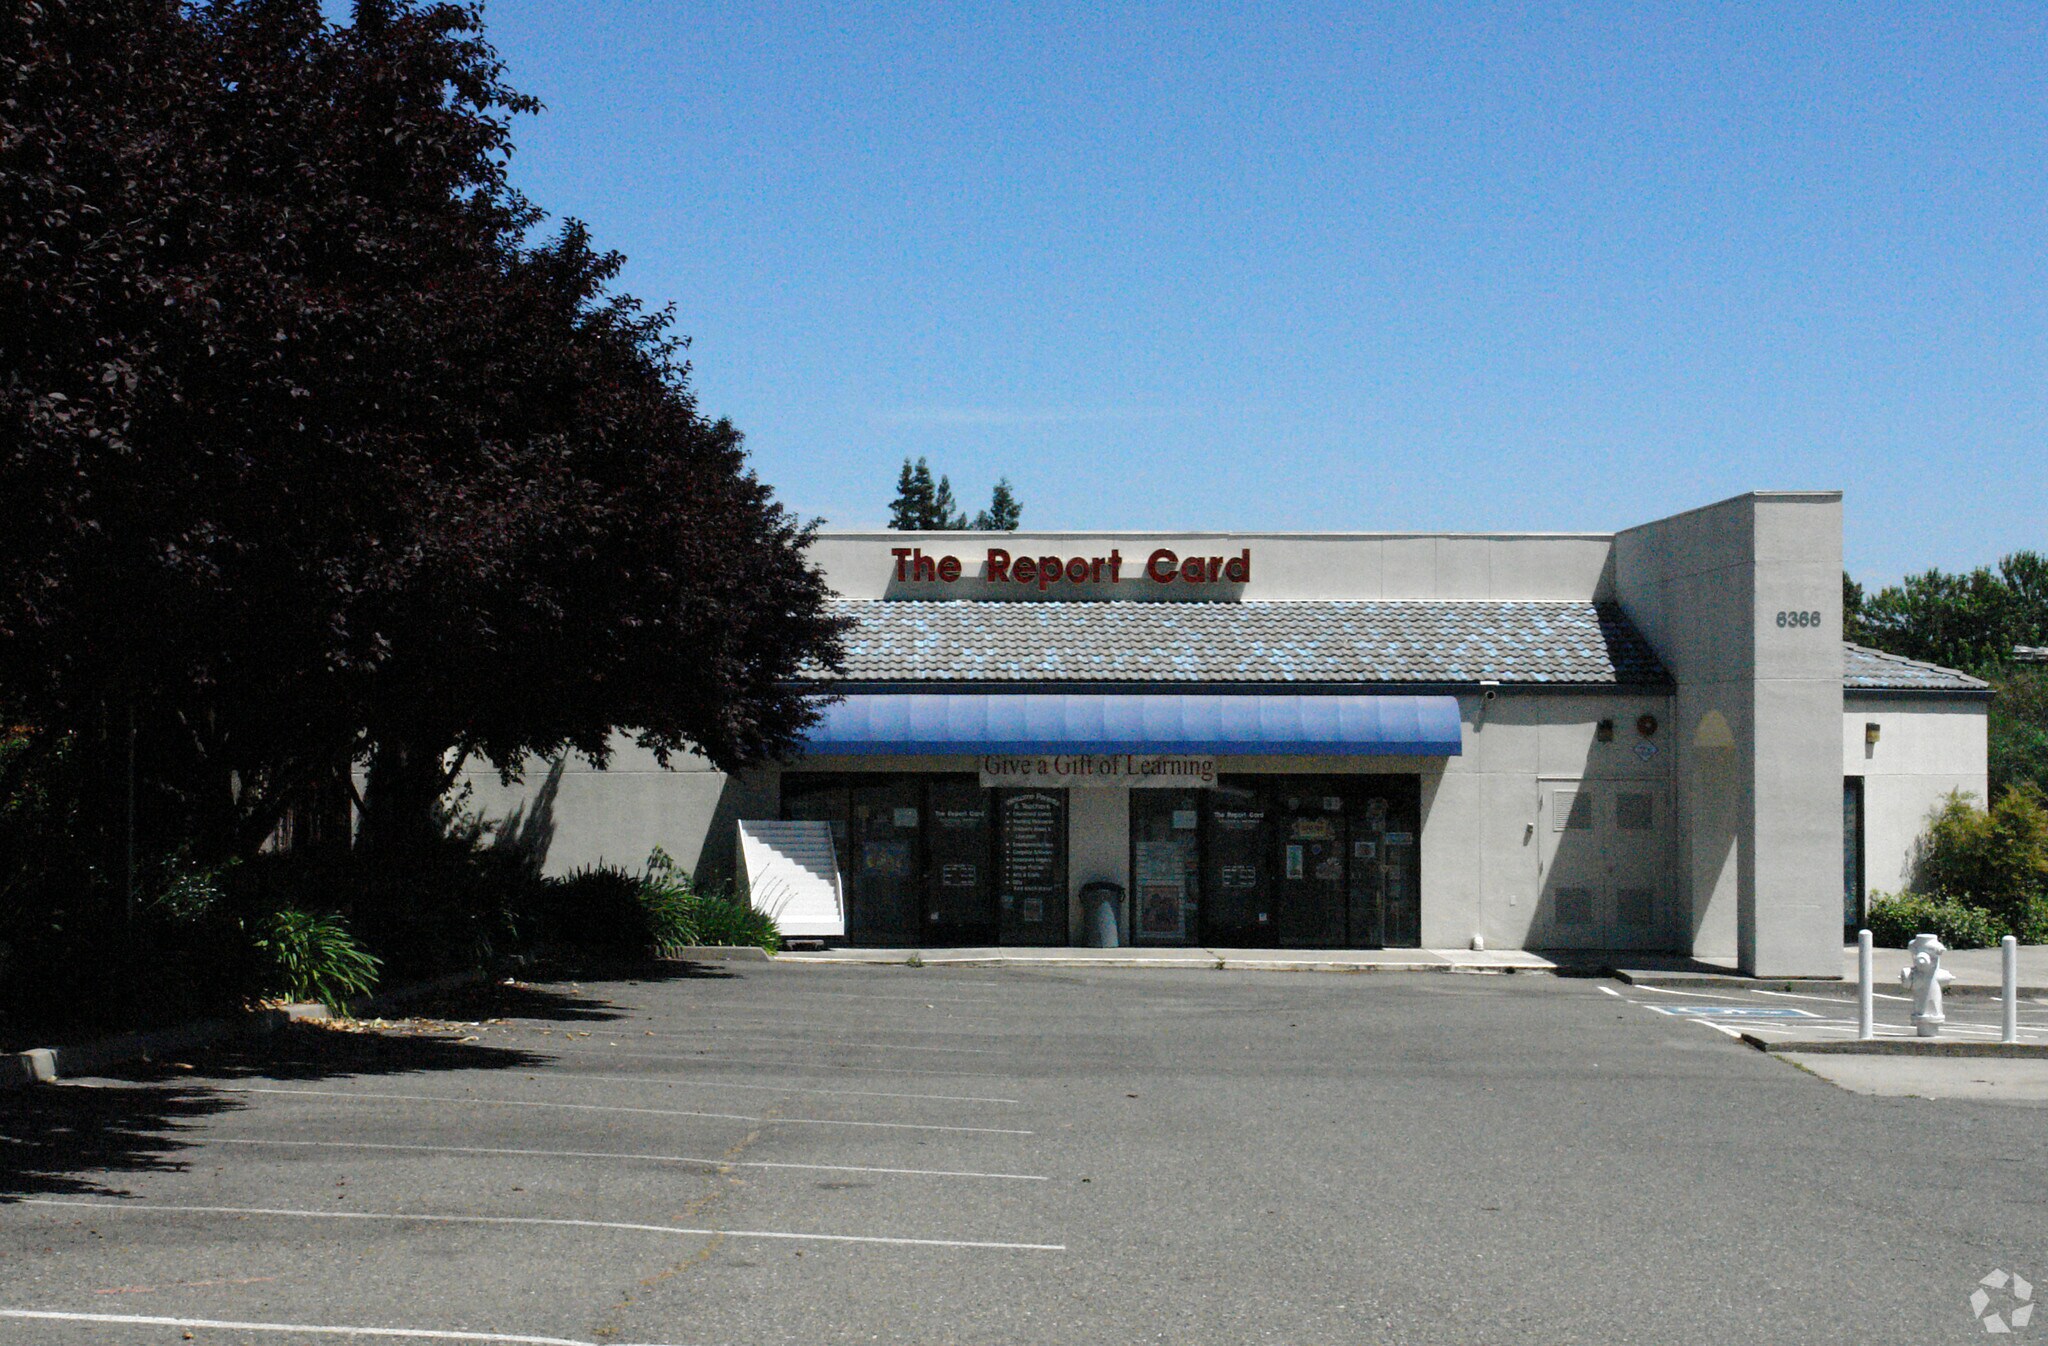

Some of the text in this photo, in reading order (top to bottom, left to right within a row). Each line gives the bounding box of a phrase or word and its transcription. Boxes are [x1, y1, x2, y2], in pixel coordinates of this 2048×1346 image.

[891, 548, 1251, 592] The Report Card
[1776, 611, 1821, 628] 6366
[984, 754, 1214, 781] Give a Gift of Learning
